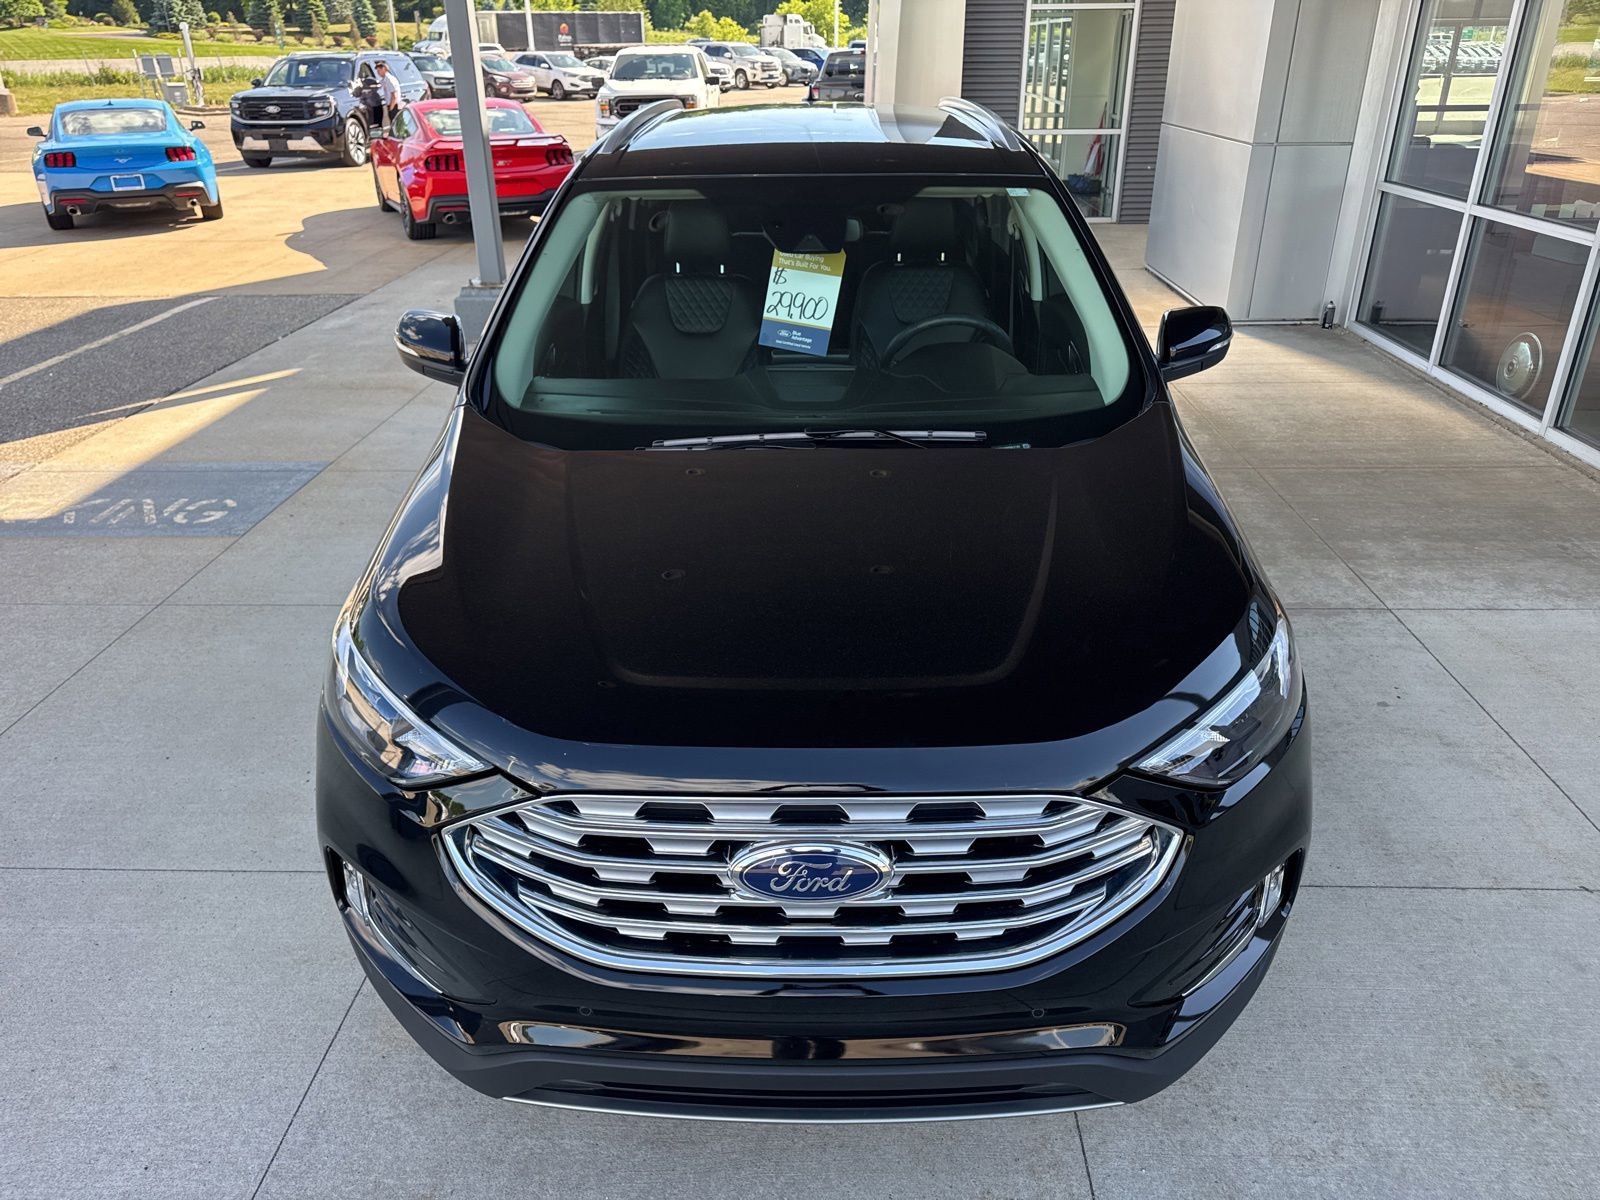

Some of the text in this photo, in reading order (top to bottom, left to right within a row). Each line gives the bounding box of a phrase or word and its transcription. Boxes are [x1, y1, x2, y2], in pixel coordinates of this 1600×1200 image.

[779, 257, 795, 266] That's
[796, 260, 809, 268] Built
[809, 262, 819, 270] For
[804, 253, 825, 263] Buying
[773, 267, 787, 285] $
[766, 291, 829, 320] 29,900
[769, 861, 853, 892] Ford
